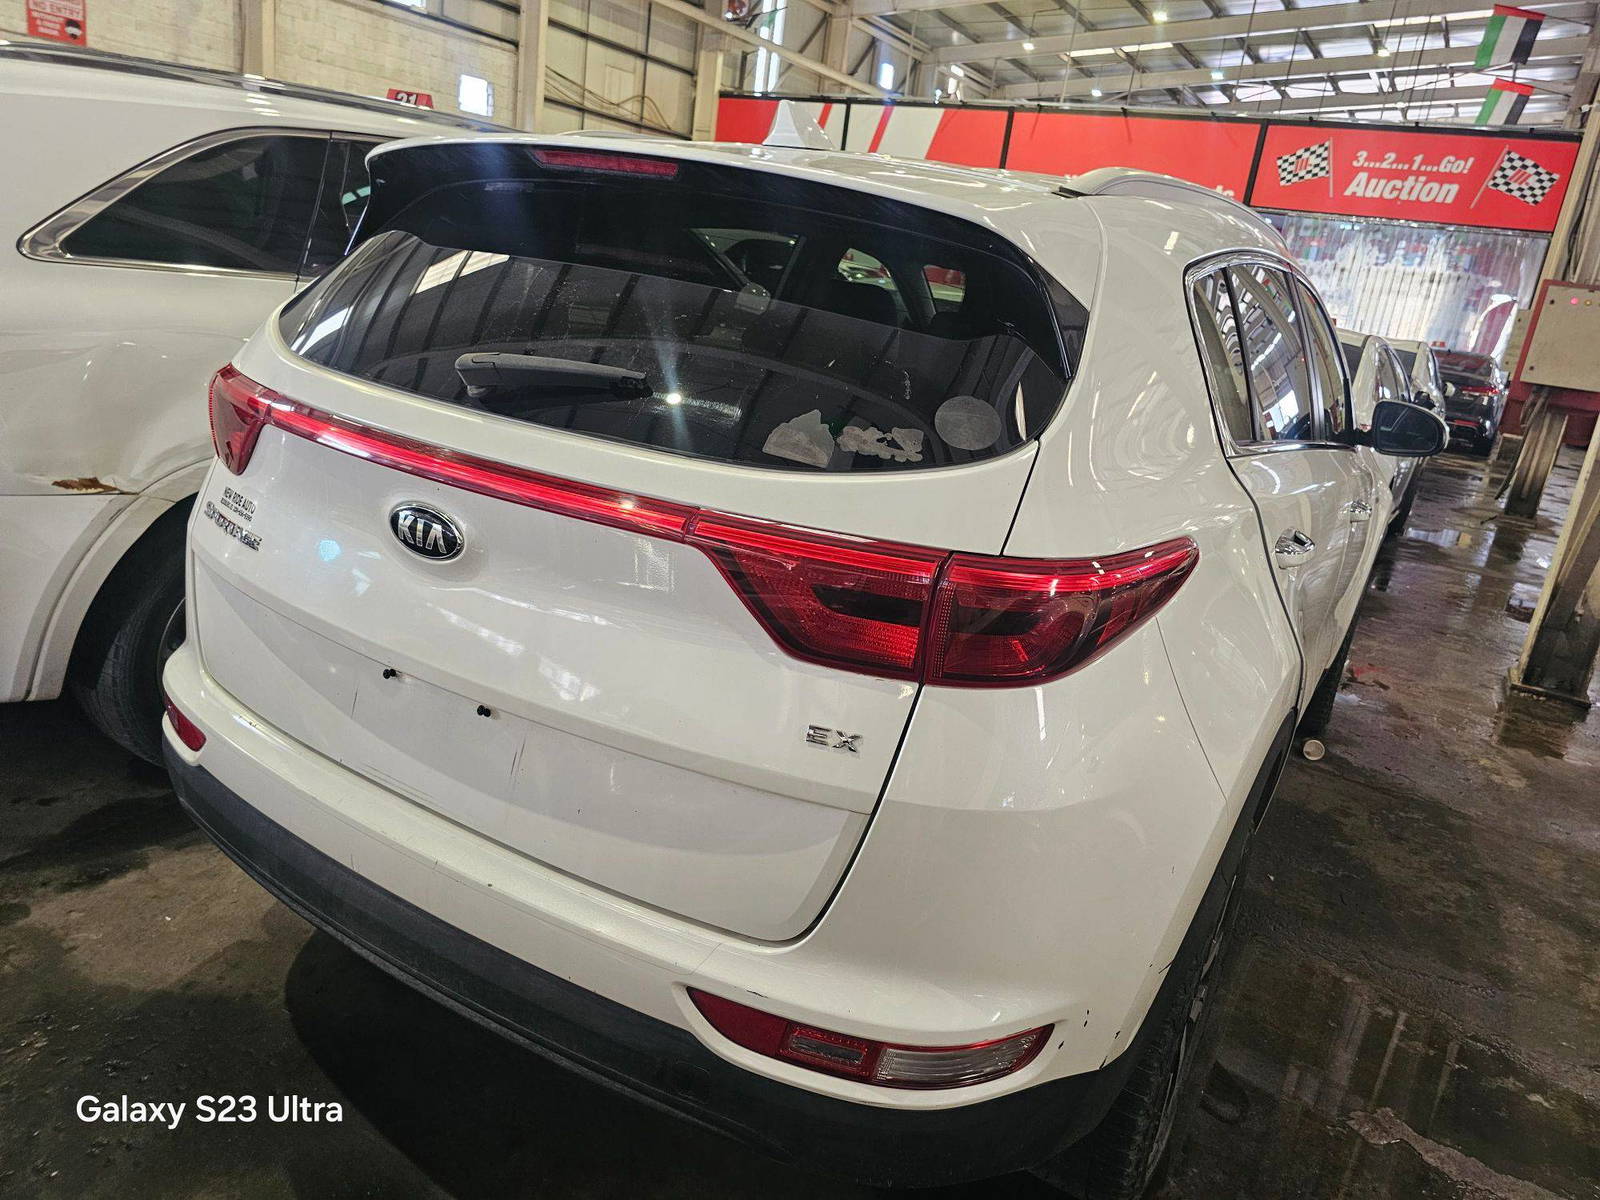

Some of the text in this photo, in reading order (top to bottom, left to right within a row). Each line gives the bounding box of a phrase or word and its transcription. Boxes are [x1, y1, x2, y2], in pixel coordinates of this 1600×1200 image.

[1344, 171, 1461, 204] Auction
[397, 510, 448, 554] KIA
[805, 725, 863, 753] EX
